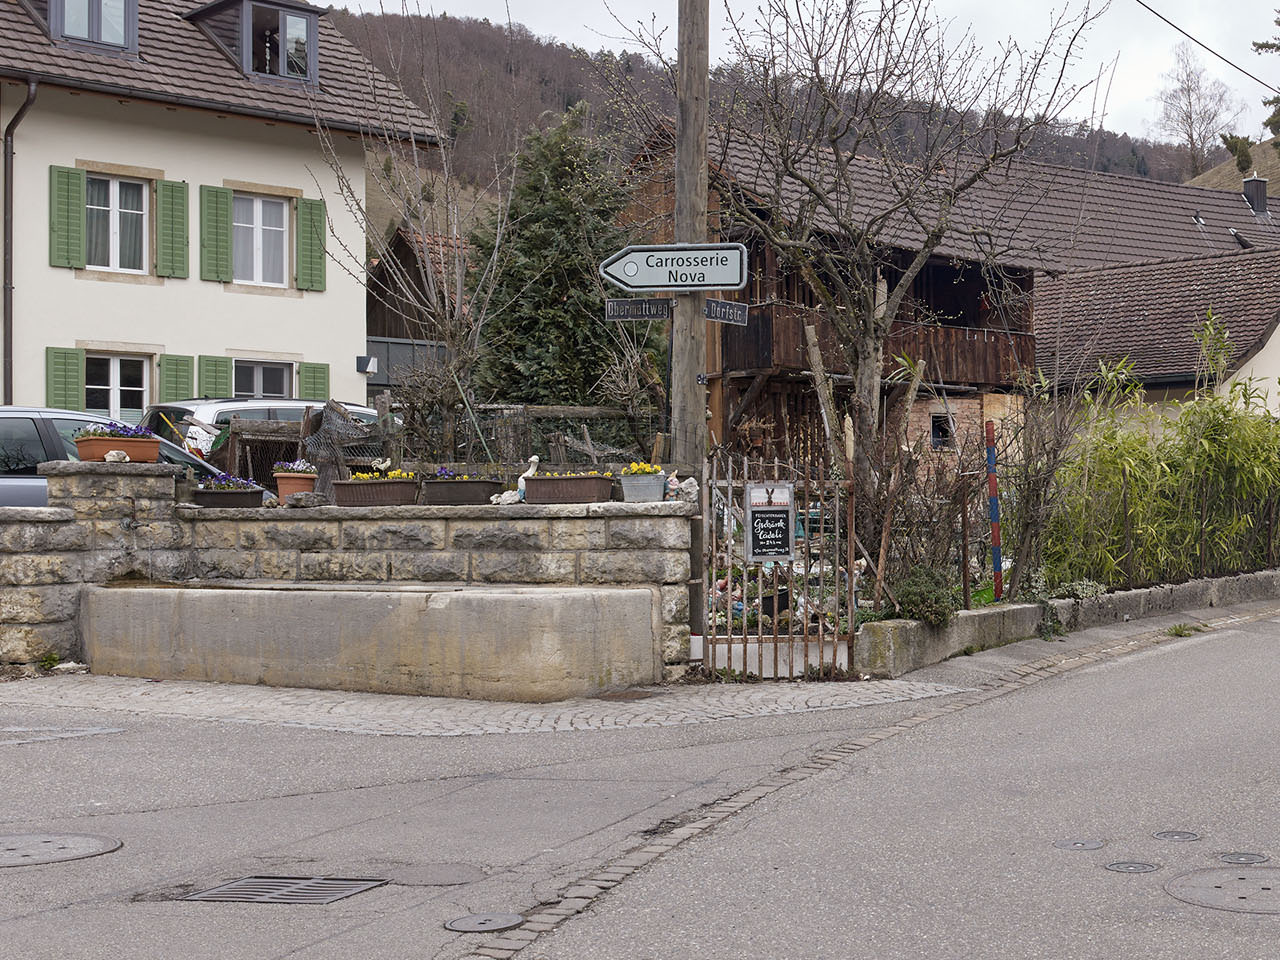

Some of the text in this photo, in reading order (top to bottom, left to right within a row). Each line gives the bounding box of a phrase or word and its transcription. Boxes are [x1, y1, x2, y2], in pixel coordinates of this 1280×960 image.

[645, 253, 729, 268] Carrosserie
[668, 270, 706, 283] Nova
[608, 301, 668, 318] Obermattweg
[711, 303, 742, 321] Dorfstr.
